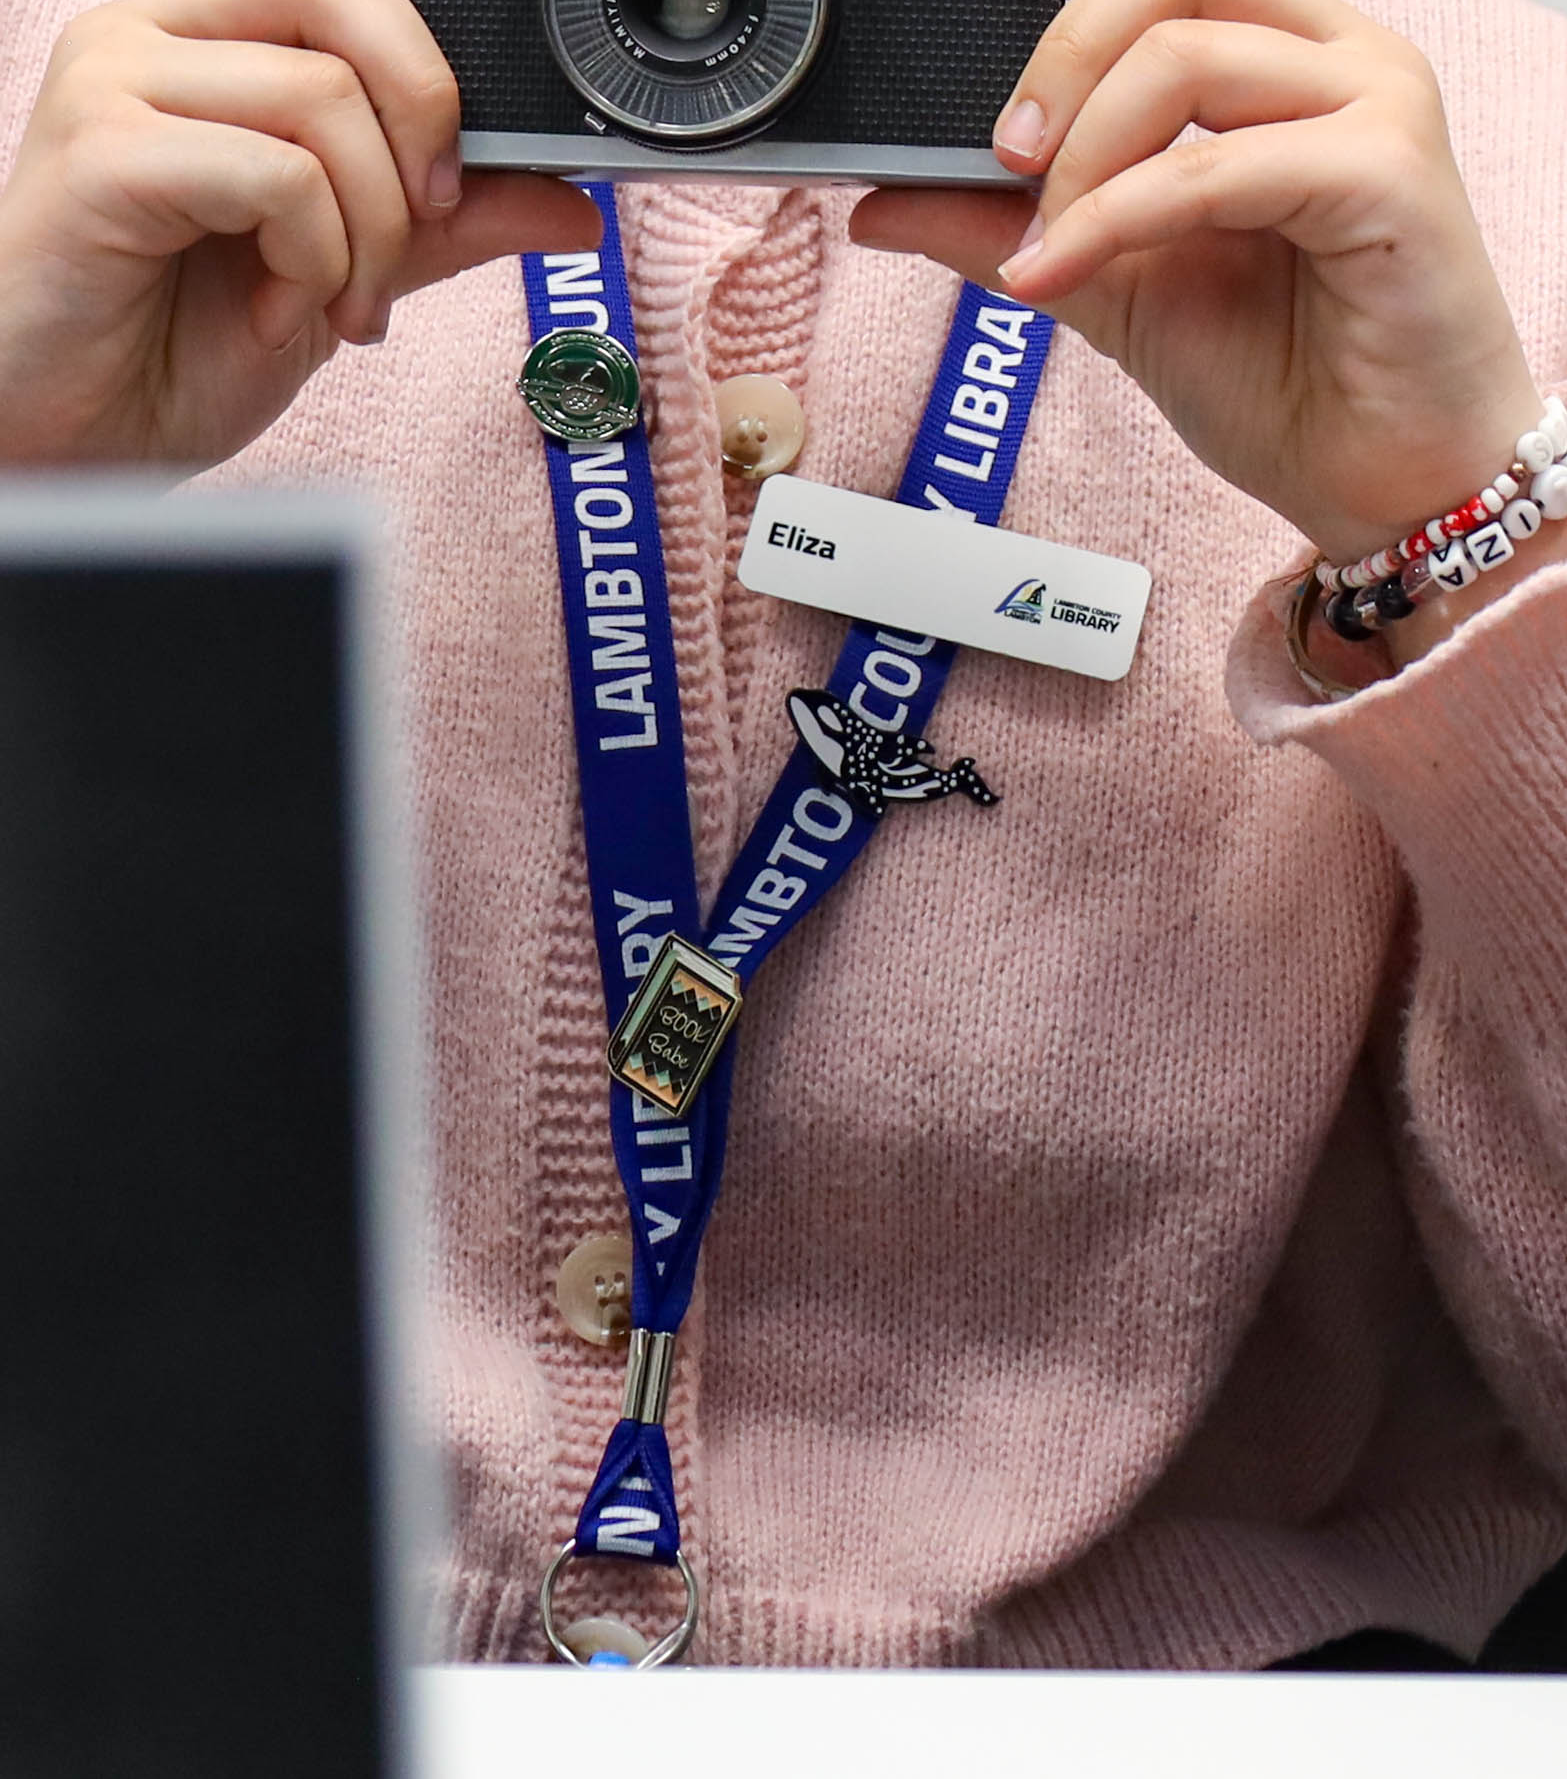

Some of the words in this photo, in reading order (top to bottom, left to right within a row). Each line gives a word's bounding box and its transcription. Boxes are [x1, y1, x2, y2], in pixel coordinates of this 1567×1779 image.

[935, 291, 1036, 482] LIBRA
[767, 522, 837, 562] Eliza
[569, 439, 660, 751] LAMBTON
[1090, 604, 1122, 620] COUNTY
[1050, 605, 1121, 635] LIBRARY
[647, 1030, 692, 1072] Babe
